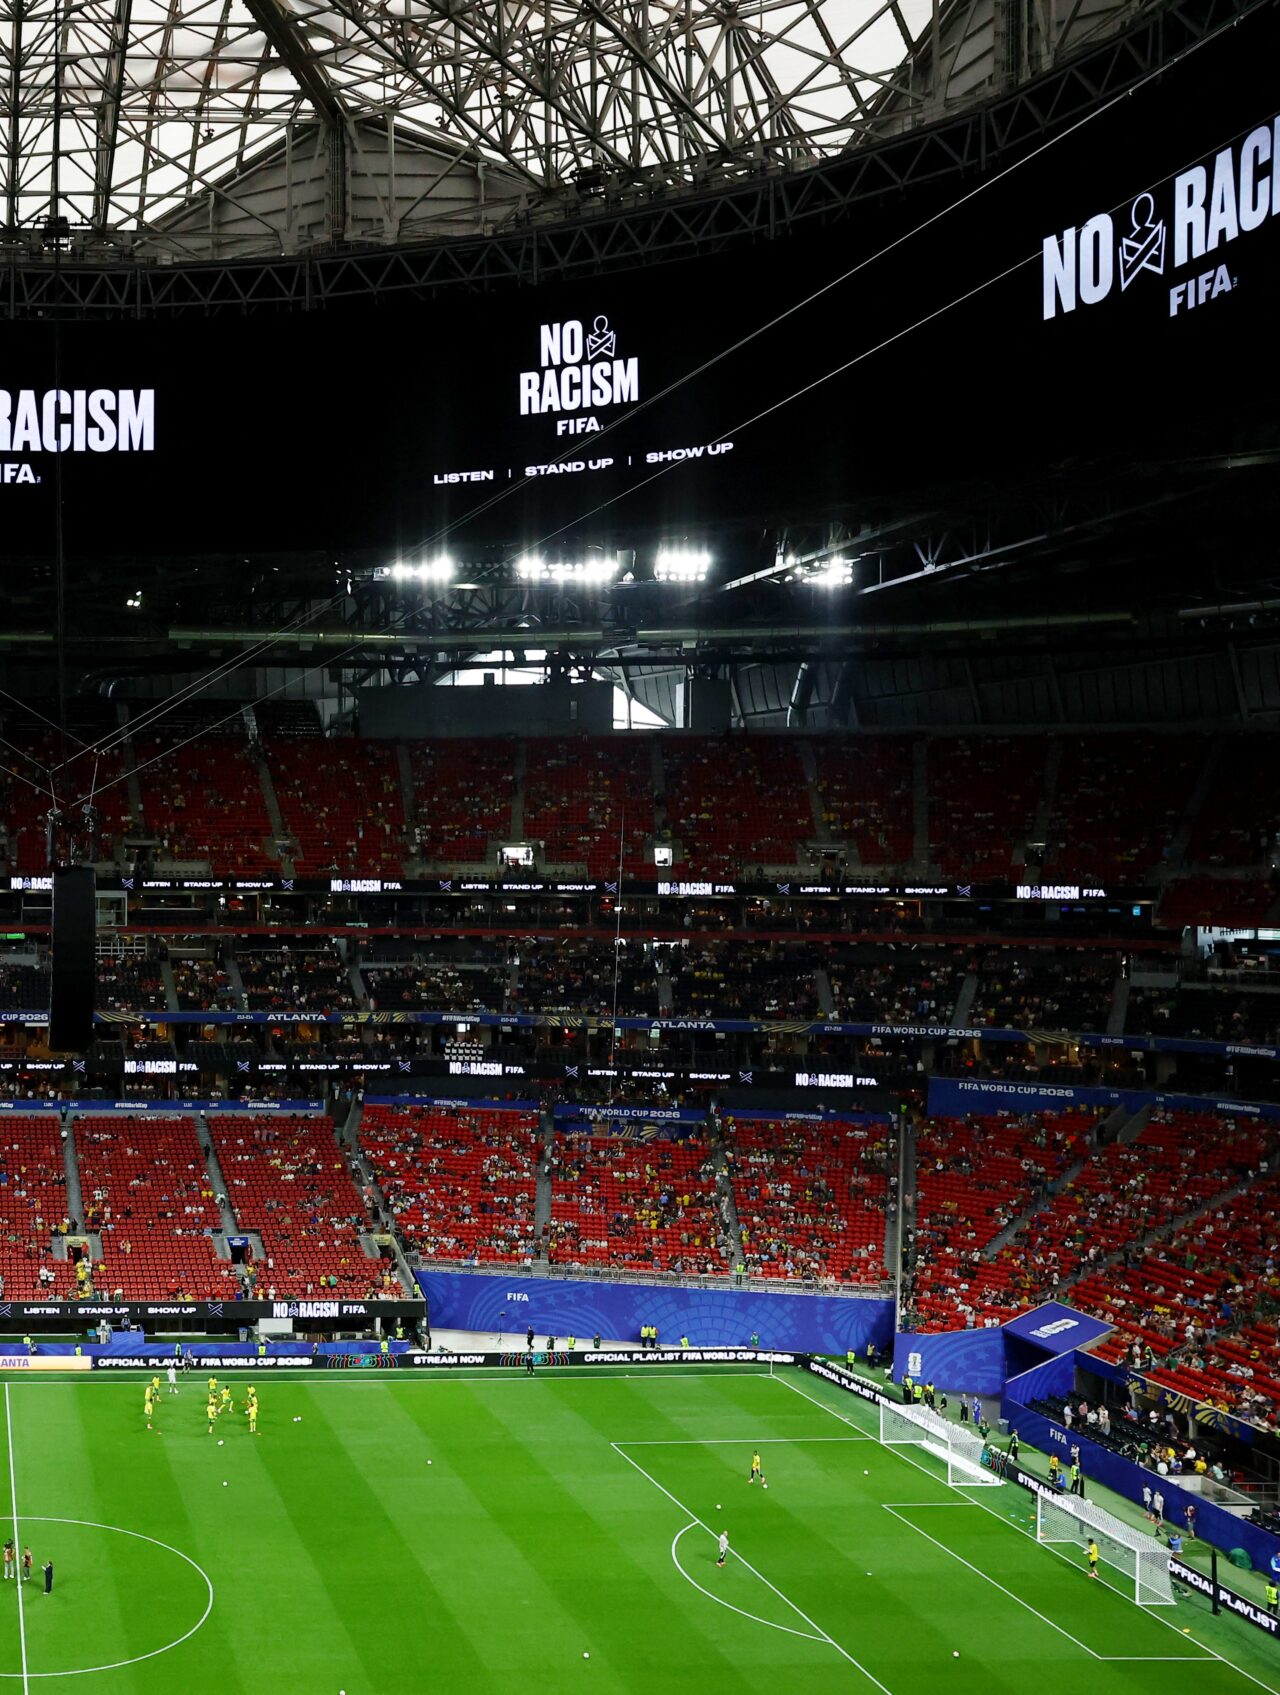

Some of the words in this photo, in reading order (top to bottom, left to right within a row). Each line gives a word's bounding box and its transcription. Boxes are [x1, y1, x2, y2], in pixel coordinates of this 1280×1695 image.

[1043, 213, 1113, 321] NO
[1175, 114, 1280, 268] RACI
[1170, 263, 1233, 318] FIFA
[540, 320, 583, 367] NO
[520, 357, 639, 415] RACISM
[557, 416, 600, 436] FIFA
[433, 470, 494, 484] LISTEN
[524, 461, 585, 477] STAND
[589, 457, 614, 470] UP
[646, 446, 704, 463] SHOW
[707, 442, 734, 456] UP
[11, 878, 23, 889] NO
[331, 880, 342, 891] NO
[351, 880, 381, 891] RACISM
[383, 882, 402, 890] FIFA
[658, 883, 670, 894] NO
[679, 883, 712, 895] RACISM
[714, 885, 735, 893] FIFA
[1017, 886, 1030, 898] NO
[1041, 886, 1079, 899] RACISM
[1082, 888, 1106, 898] FIFA
[1, 1013, 19, 1021] CUP
[19, 1013, 49, 1021] 2026
[266, 1013, 327, 1021] ATLANTA
[651, 1020, 716, 1030] ATLANTA
[871, 1026, 892, 1034] FIFA
[892, 1026, 927, 1035] WORLD
[927, 1027, 947, 1036] CUP
[948, 1028, 982, 1038] 2026
[125, 1061, 136, 1073] NO
[145, 1061, 176, 1073] RACISM
[178, 1063, 199, 1071] FIFA
[796, 1073, 808, 1086] NO
[817, 1074, 853, 1087] RACISM
[856, 1077, 878, 1086] FIFA
[958, 1082, 979, 1091] FIFA
[980, 1083, 1016, 1093] WORLD
[1017, 1086, 1038, 1095] CUP
[1038, 1087, 1074, 1097] 2026
[631, 1109, 649, 1117] CUP
[649, 1110, 681, 1119] 2026
[506, 1292, 529, 1302] FIFA
[23, 1307, 60, 1315] LISTEN
[273, 1302, 288, 1317] NO
[299, 1302, 339, 1317] RACISM
[342, 1304, 366, 1314] FIFA
[98, 1358, 146, 1367] OFFICIAL
[149, 1357, 199, 1367] PLAYLIT
[201, 1357, 221, 1367] FIFA
[222, 1357, 256, 1367] WORLD
[257, 1357, 276, 1367] CUP
[414, 1355, 457, 1365] STREAM
[460, 1355, 485, 1364] NOW
[584, 1353, 630, 1362] OFFICIAL
[633, 1352, 680, 1362] PLAYLIST
[683, 1351, 702, 1361] FIFA
[703, 1351, 736, 1361] WORLD
[737, 1351, 756, 1361] CUP
[810, 1362, 840, 1383] OFFICIAL
[841, 1377, 875, 1399] PLAYLIST
[1049, 1428, 1067, 1445] FIFA
[1219, 1589, 1278, 1632] PLAYLIST
